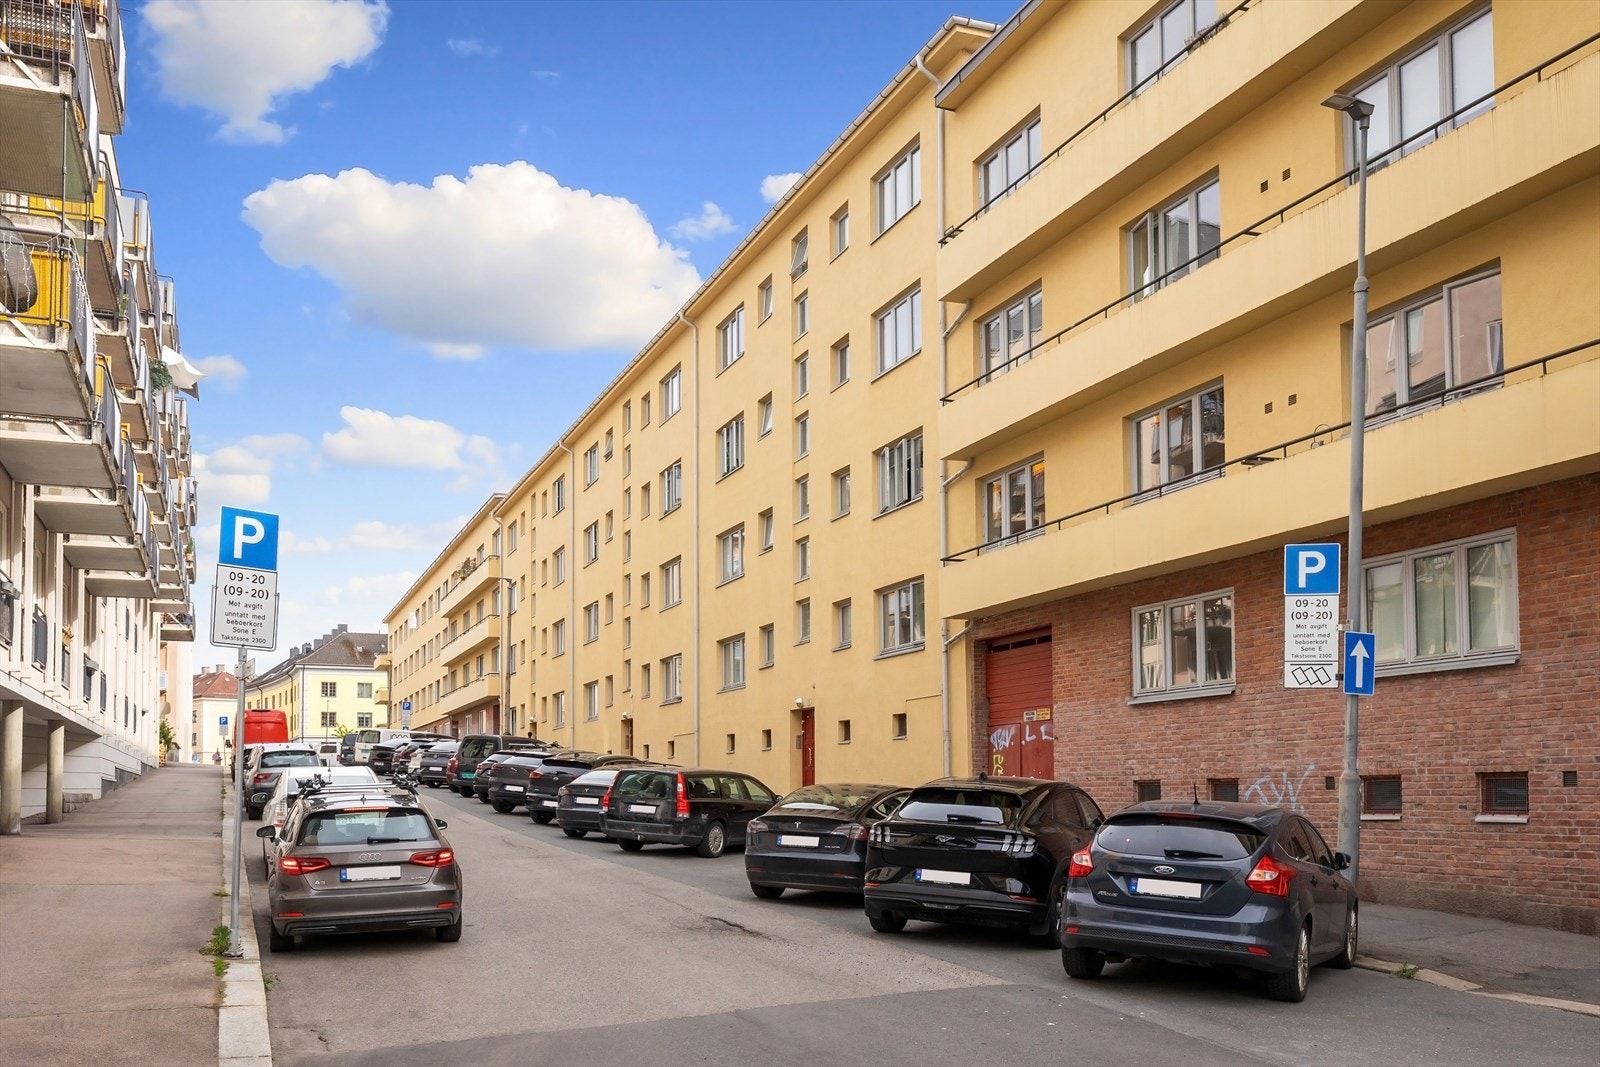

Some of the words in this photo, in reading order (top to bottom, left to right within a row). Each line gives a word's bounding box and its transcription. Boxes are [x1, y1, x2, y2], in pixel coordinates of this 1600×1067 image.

[233, 515, 265, 560] P
[1298, 551, 1326, 588] P
[228, 600, 241, 608] Mot
[243, 602, 263, 611] avgift
[224, 611, 249, 619] unntatt
[226, 618, 263, 628] beboerkort
[232, 626, 249, 635] Sone
[221, 634, 249, 643] Takstsone
